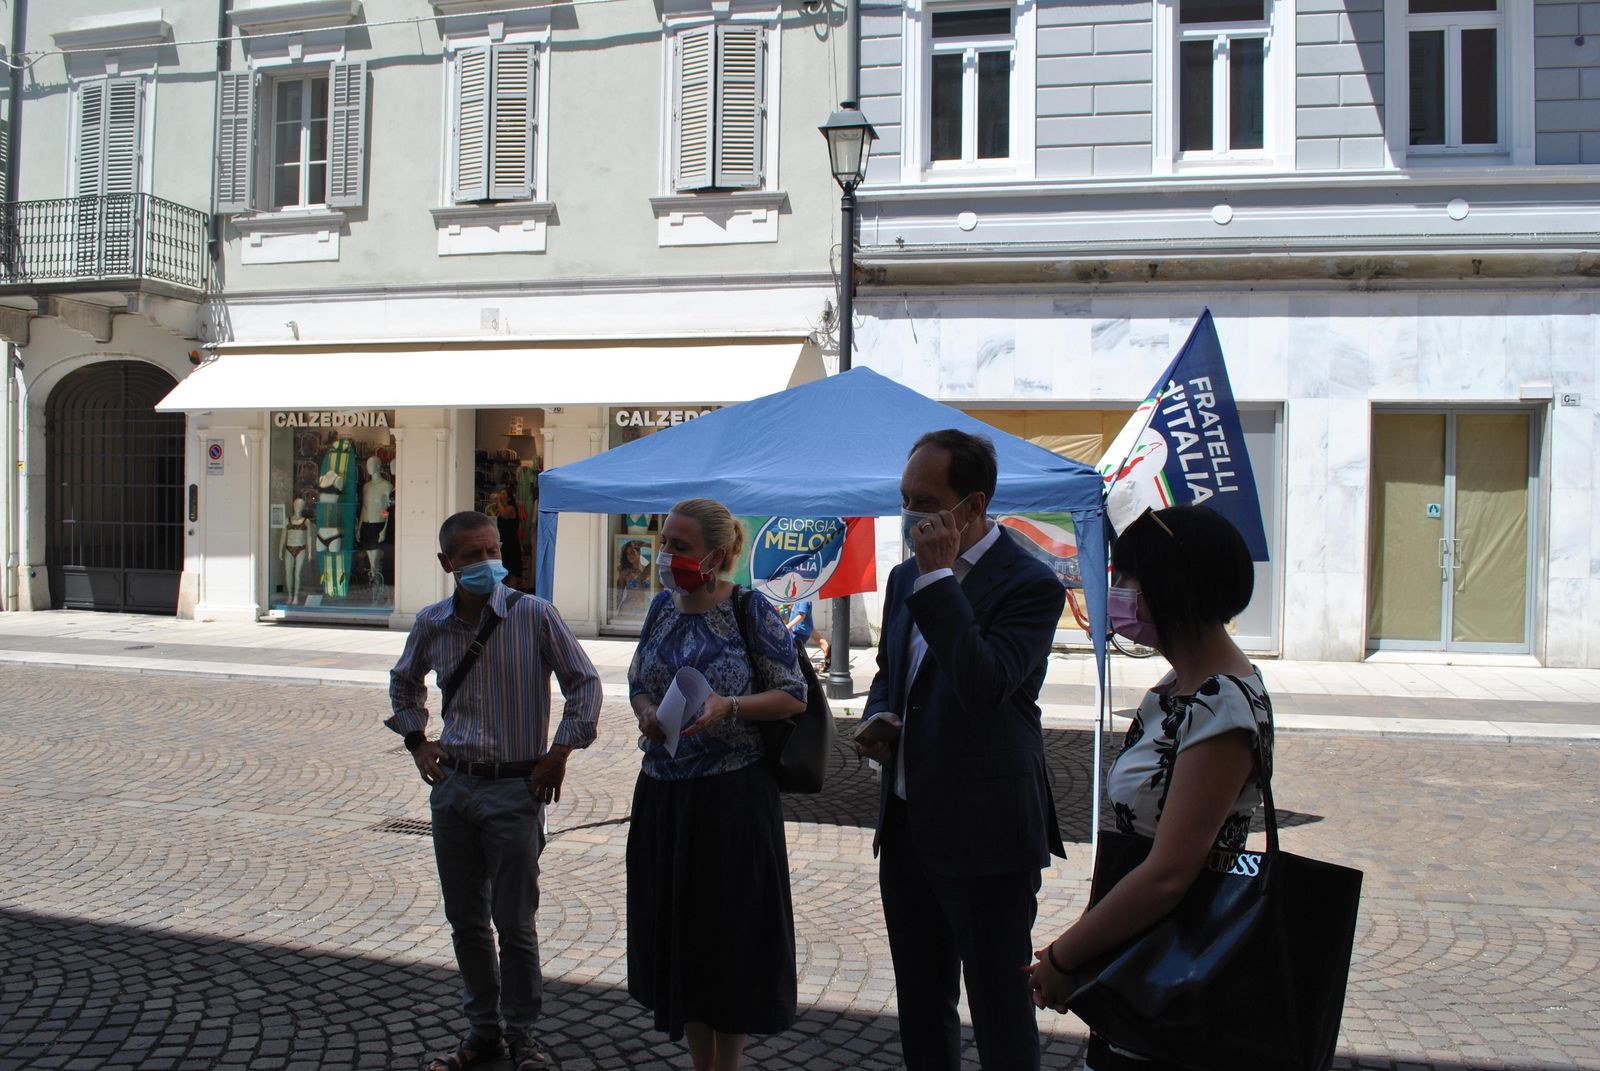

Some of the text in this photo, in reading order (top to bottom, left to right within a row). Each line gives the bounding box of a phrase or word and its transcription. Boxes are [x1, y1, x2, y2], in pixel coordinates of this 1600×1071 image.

[274, 411, 389, 428] CALZEDONIA
[615, 409, 712, 427] CALZED
[1188, 376, 1239, 492] FRATELLI
[777, 517, 838, 533] GIORGIA
